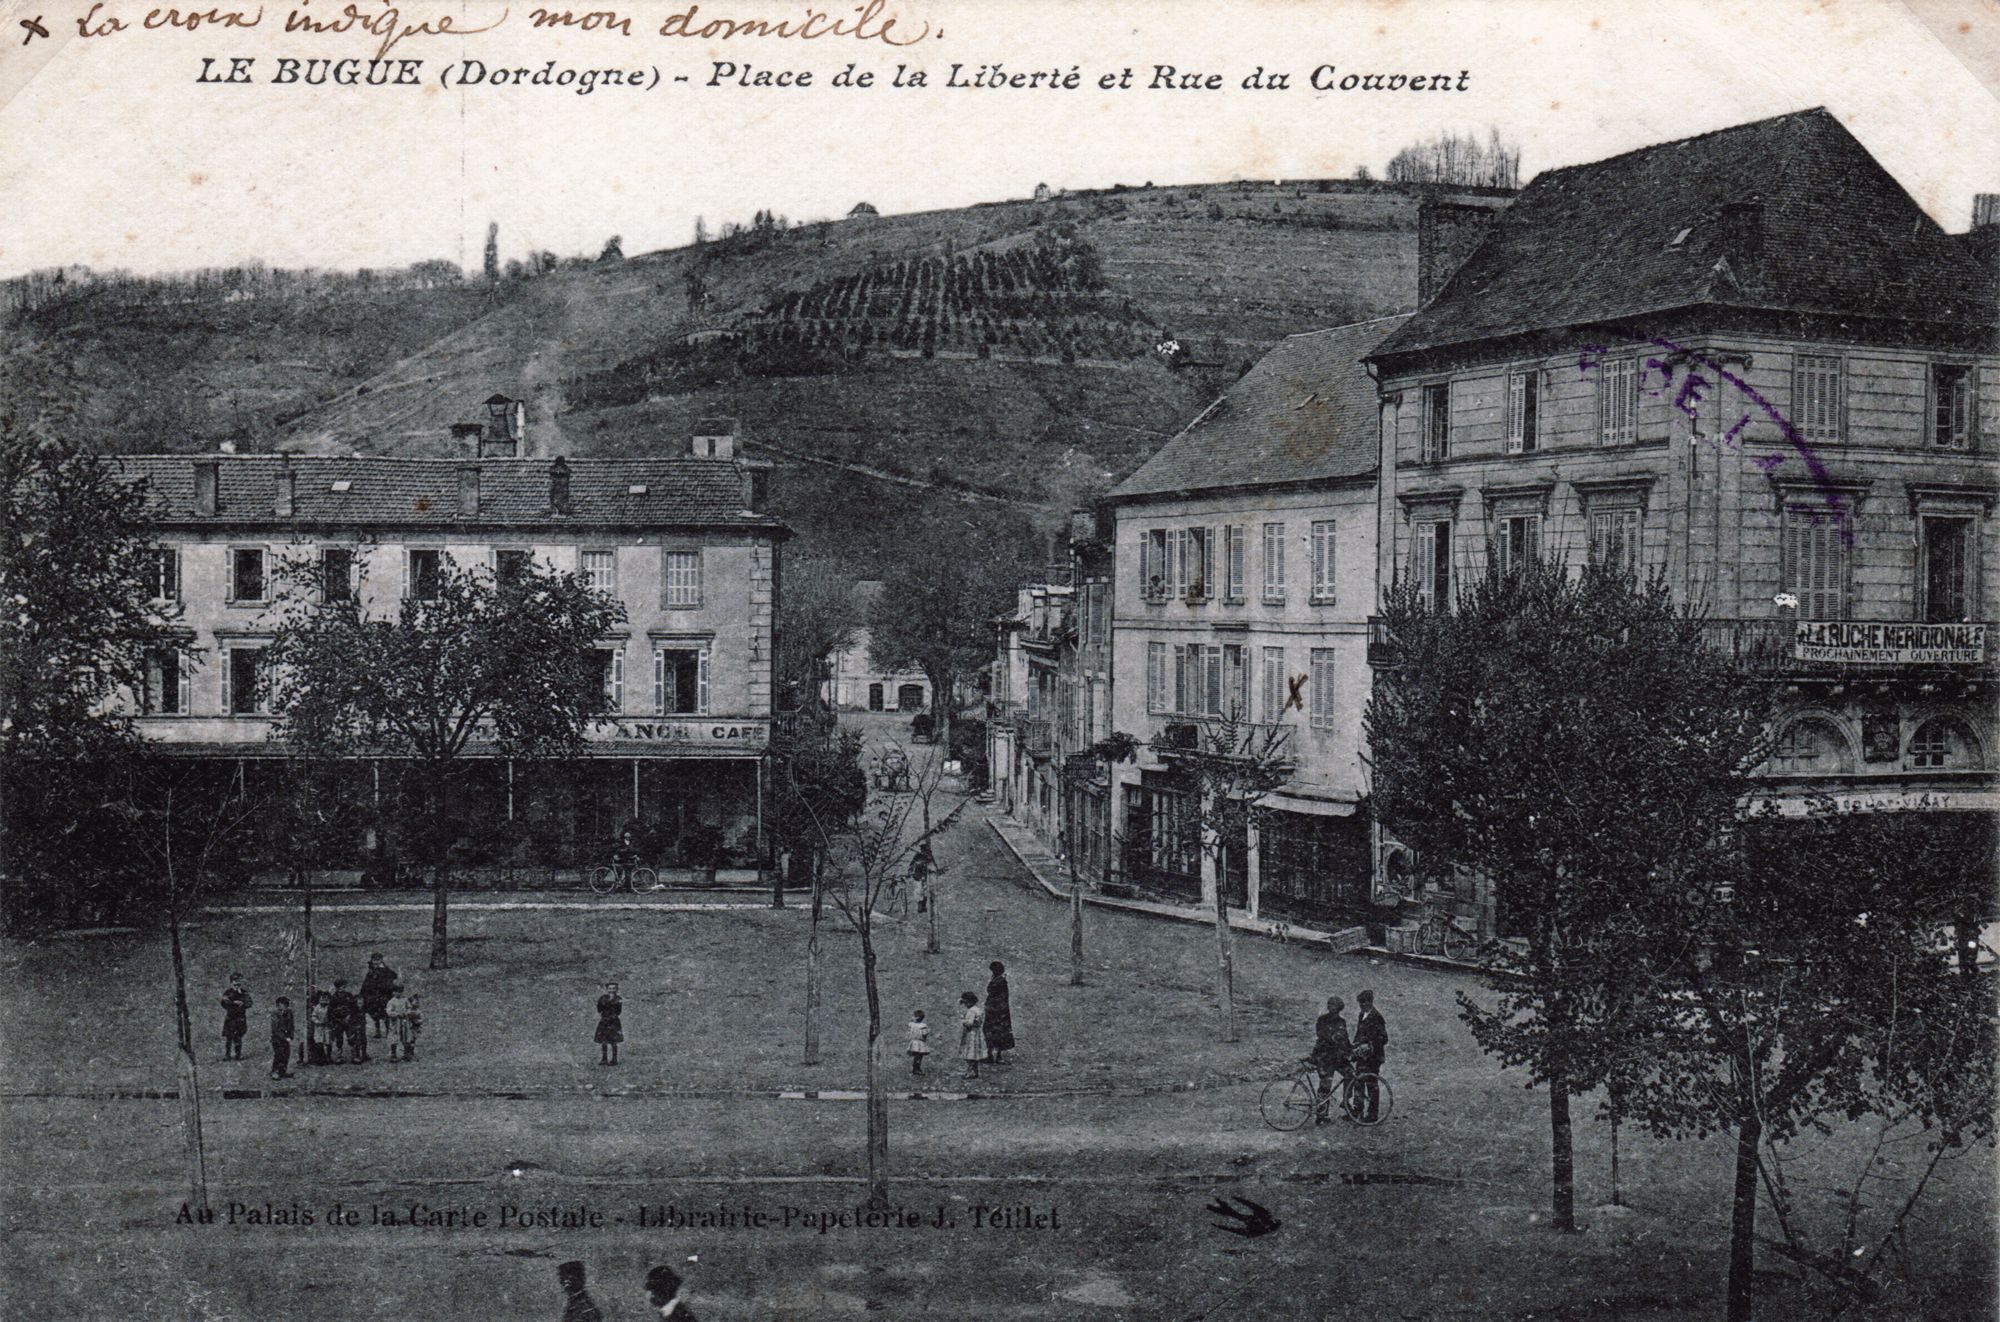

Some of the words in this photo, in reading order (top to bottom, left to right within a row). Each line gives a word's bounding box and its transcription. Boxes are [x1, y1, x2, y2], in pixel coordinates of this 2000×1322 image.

[76, 3, 128, 39] La
[143, 4, 263, 31] croix
[284, 0, 508, 62] indique
[528, 5, 632, 37] mon
[1802, 647, 1901, 661] PROCHAINEMENT
[1910, 650, 1979, 661] OUVERTURE
